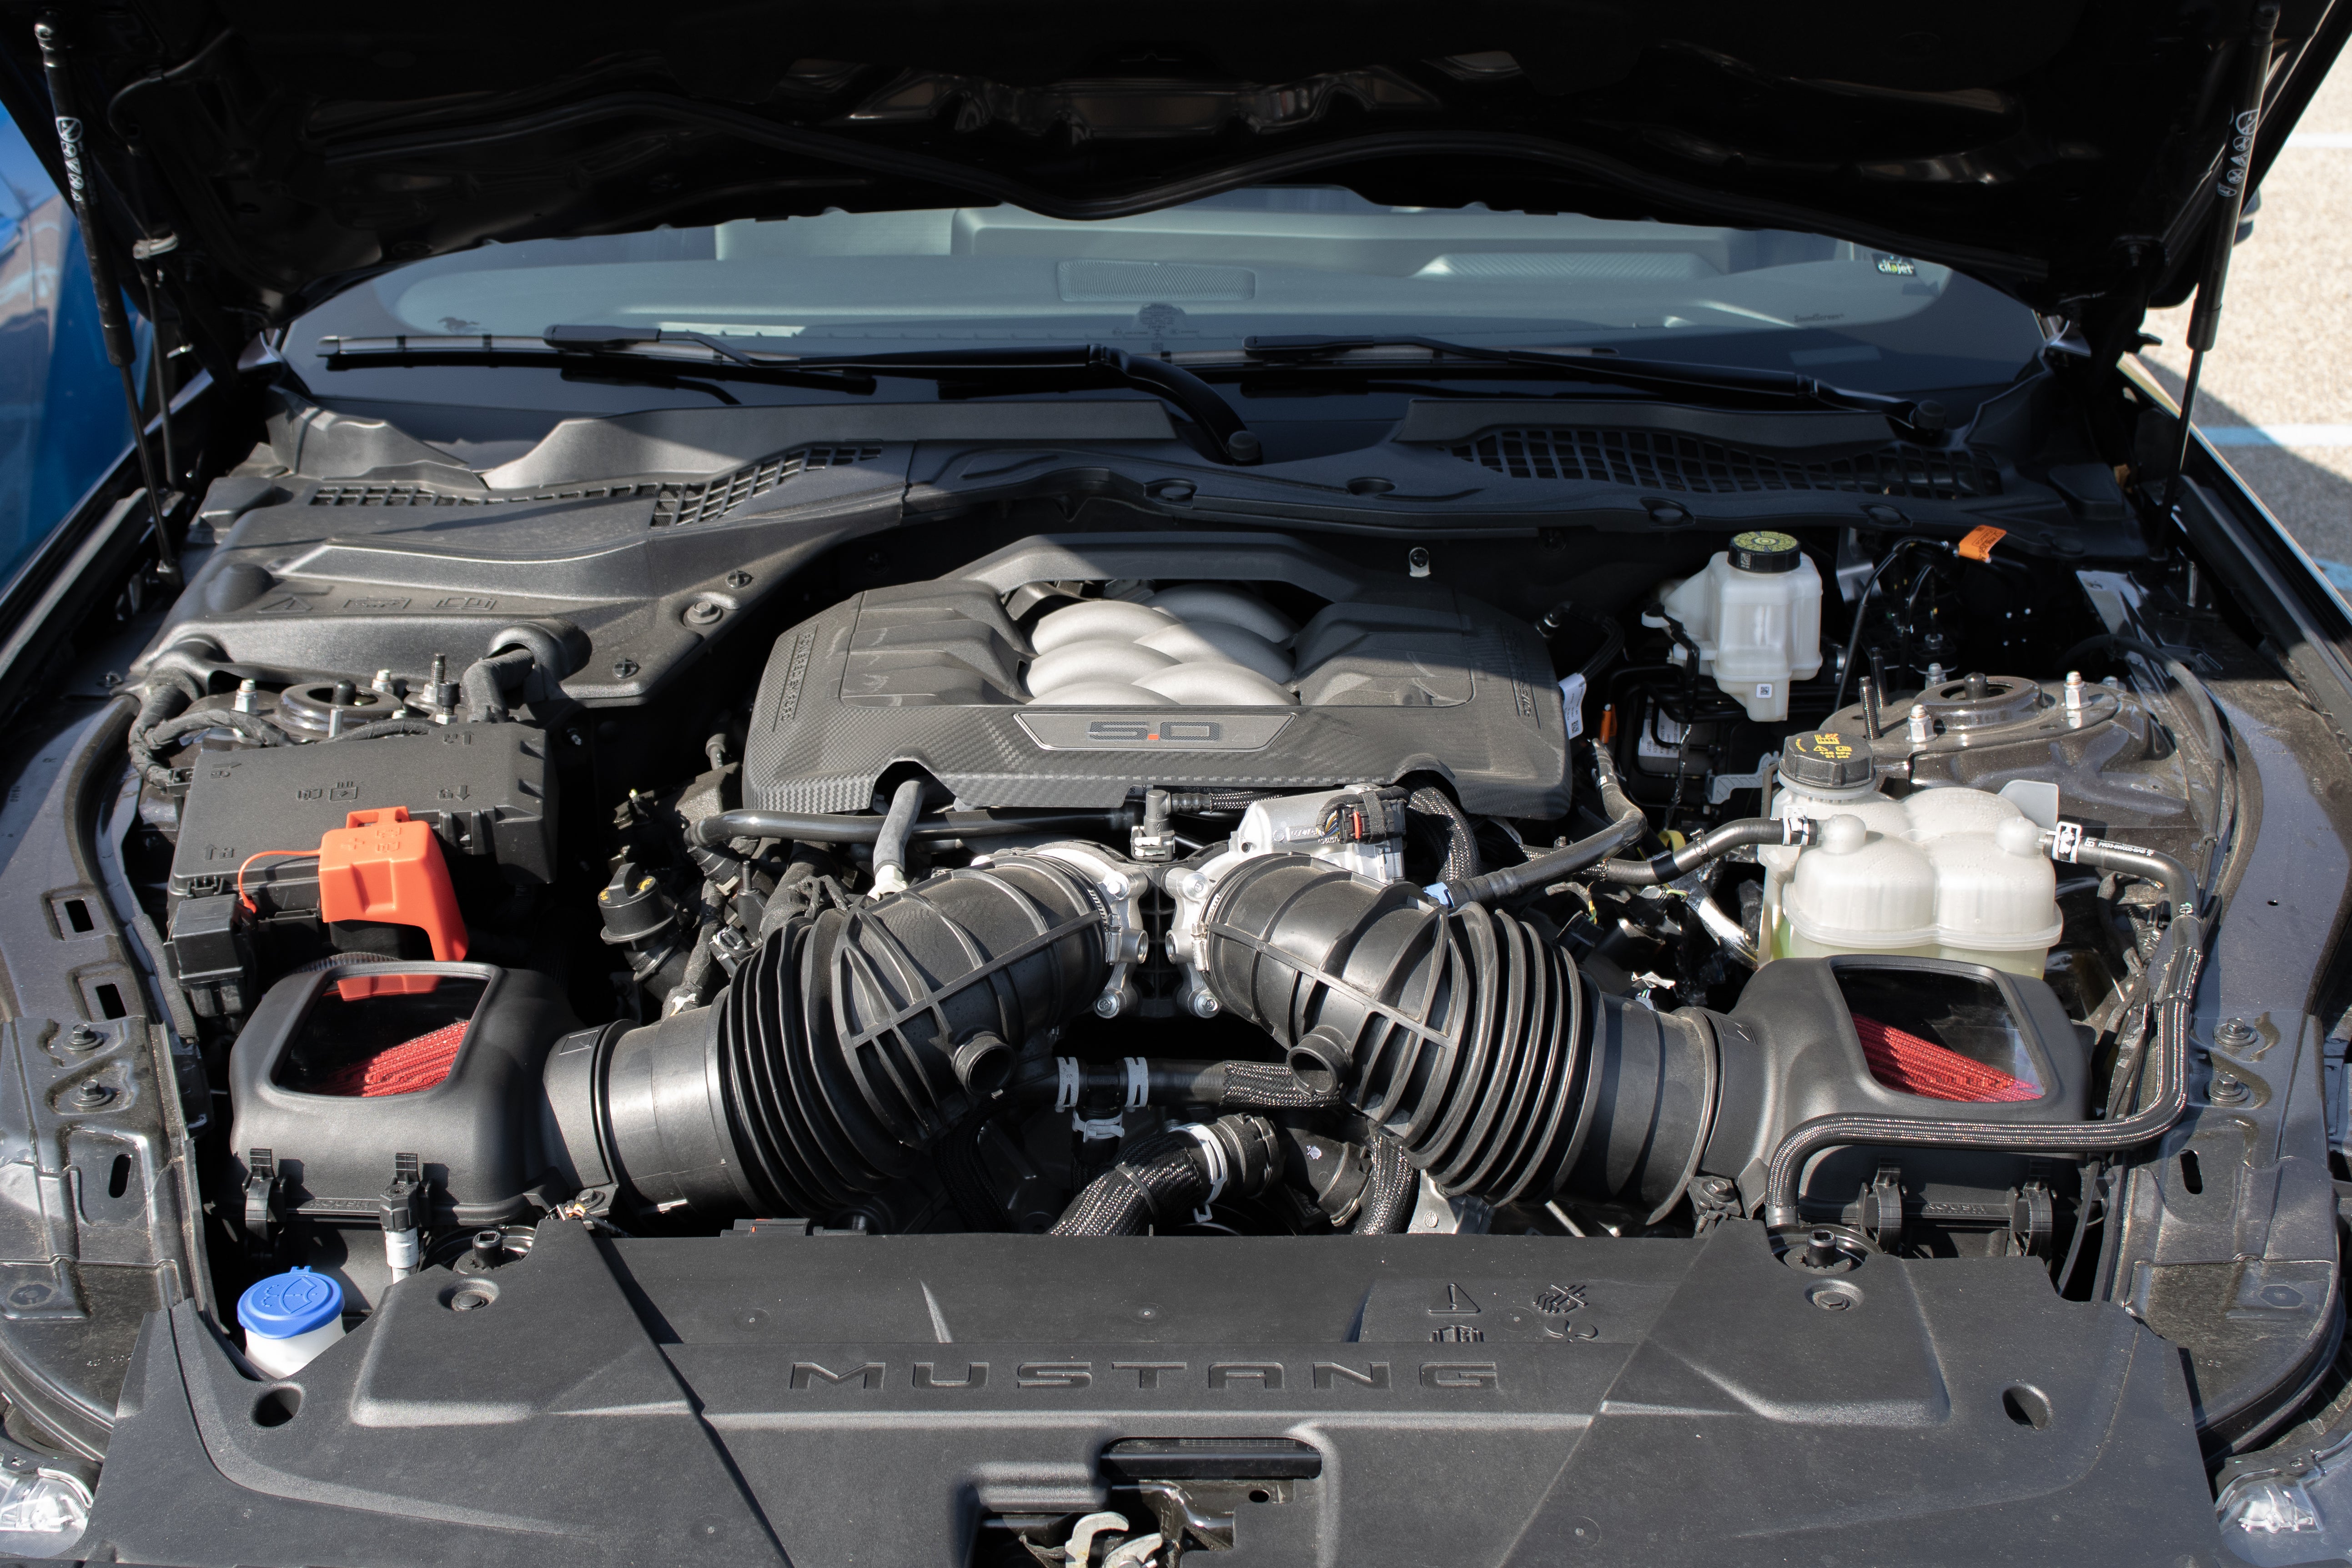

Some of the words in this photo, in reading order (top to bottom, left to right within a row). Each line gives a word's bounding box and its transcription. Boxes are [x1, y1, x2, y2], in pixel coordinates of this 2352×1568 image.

[792, 632, 812, 677] POWERED
[789, 678, 800, 691] BY
[781, 693, 796, 721] FORD
[1088, 721, 1219, 740] 5.0
[1926, 1203, 1985, 1211] ROUSH
[789, 1362, 1499, 1389] MUSTANG
